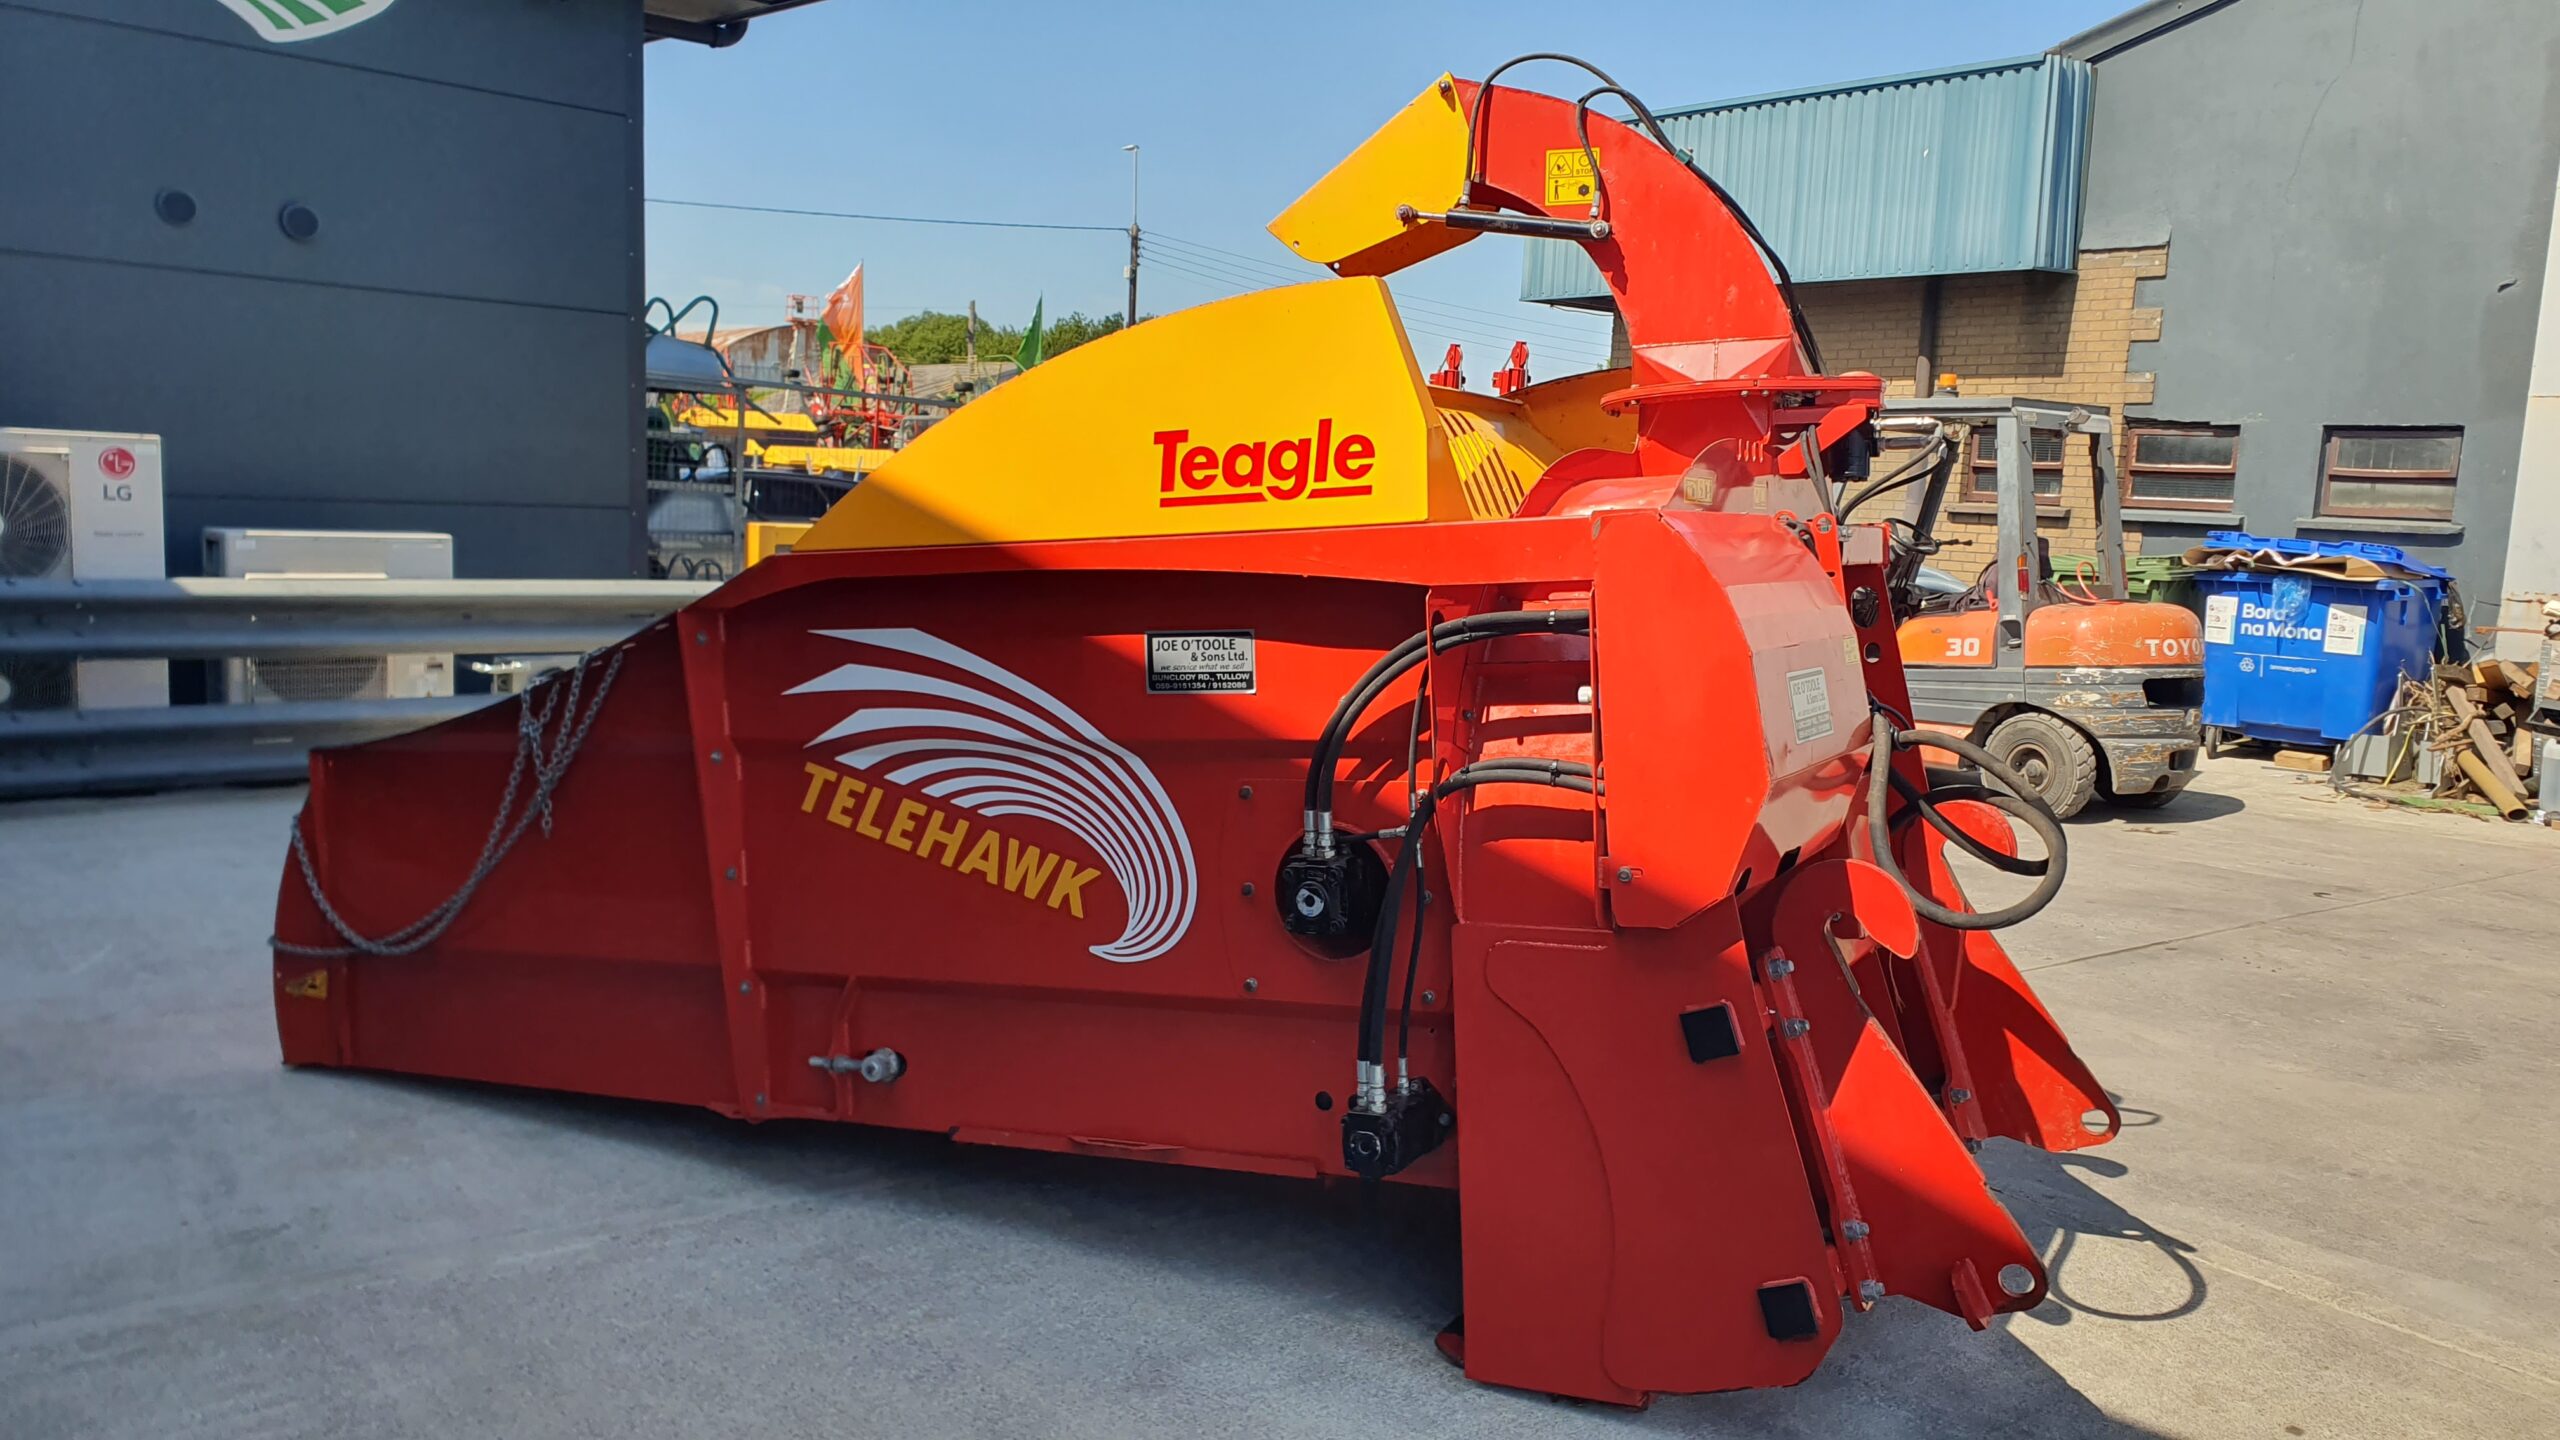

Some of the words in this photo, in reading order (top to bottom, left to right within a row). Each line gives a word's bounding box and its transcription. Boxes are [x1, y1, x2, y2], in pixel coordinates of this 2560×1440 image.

[1153, 418, 1376, 502] Teagle
[103, 484, 132, 501] LG
[2240, 623, 2265, 636] na
[1155, 640, 1178, 651] JOE
[1181, 639, 1236, 651] O'TOOLE
[1945, 637, 1980, 657] 30
[1191, 652, 1199, 662] &
[1201, 651, 1225, 662] Sons
[1228, 651, 1248, 661] Ltd.
[1172, 662, 1197, 671] service
[1200, 662, 1218, 670] what
[801, 761, 1102, 919] TELEHAWK
